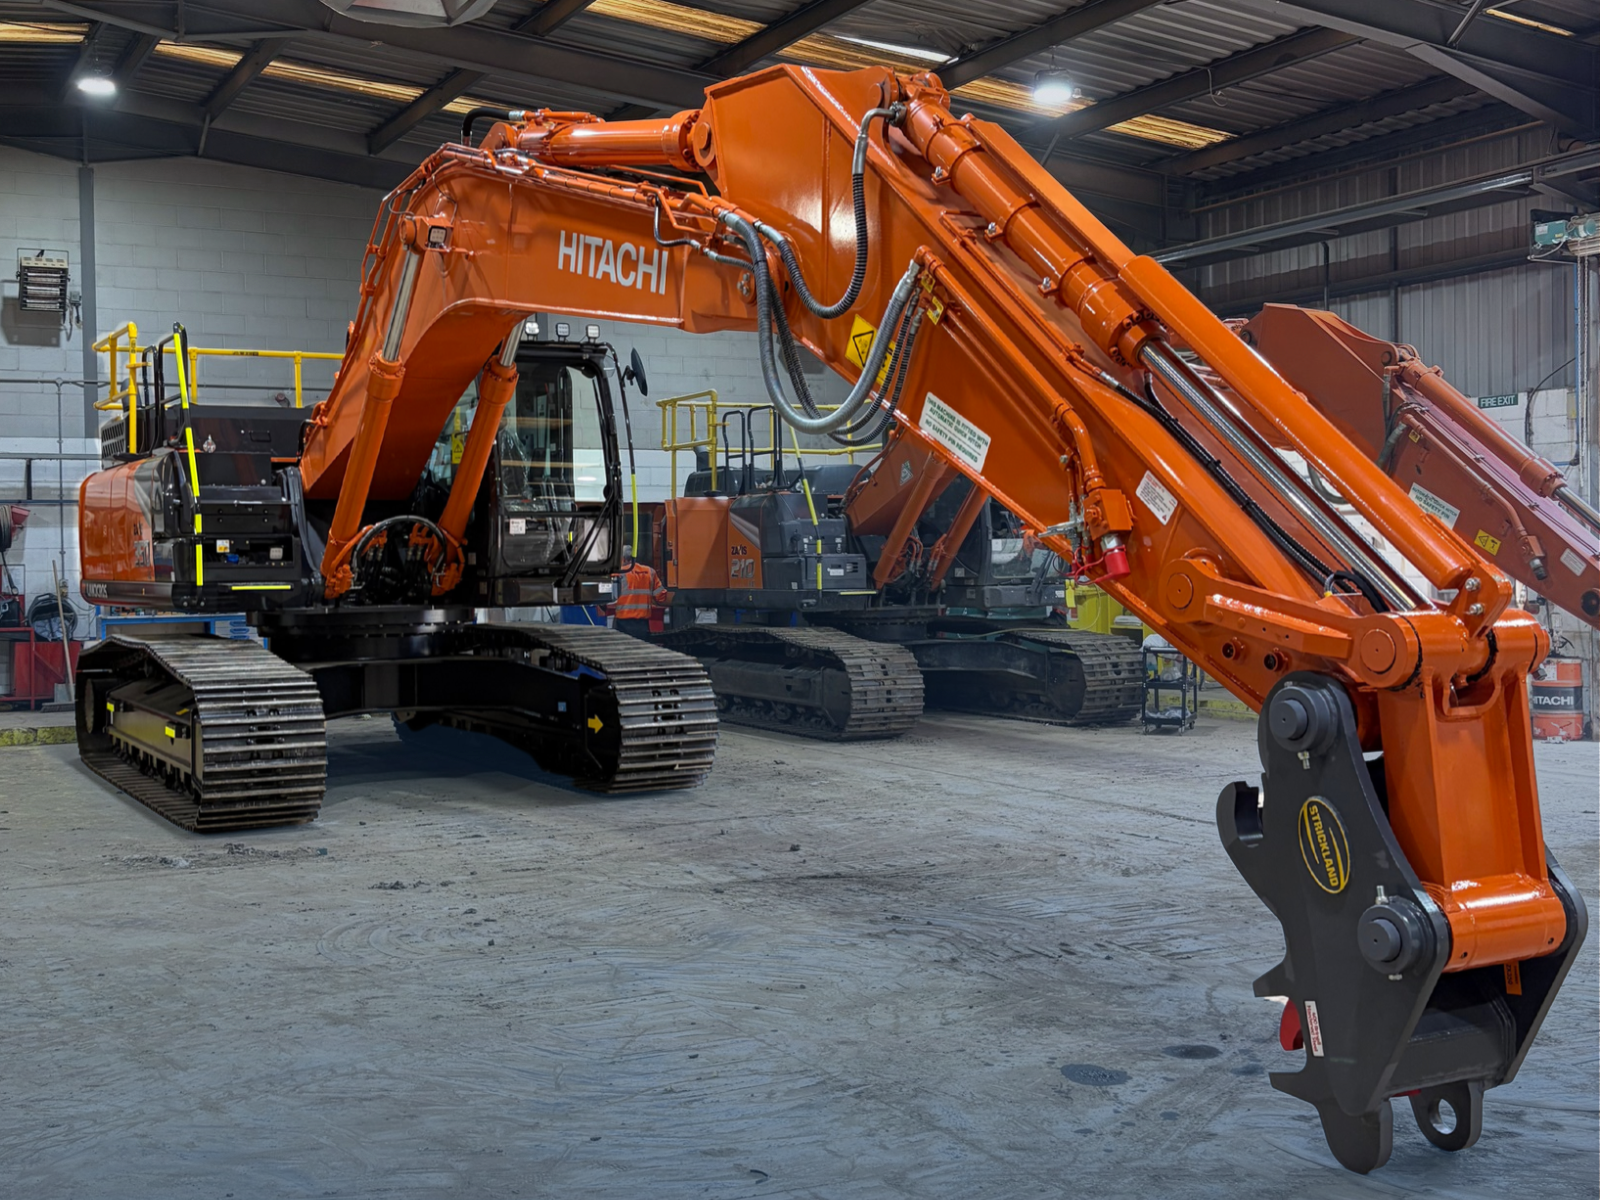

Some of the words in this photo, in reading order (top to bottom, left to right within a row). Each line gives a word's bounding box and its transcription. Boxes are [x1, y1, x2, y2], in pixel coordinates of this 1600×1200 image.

[558, 230, 669, 295] HITACHI
[1481, 397, 1497, 407] FIRE
[1498, 395, 1515, 405] EXIT
[925, 419, 933, 428] NO
[932, 424, 948, 439] SAFETY
[948, 436, 956, 446] PIN
[956, 442, 978, 463] REQUIRED
[929, 407, 954, 429] AUTOMATIC
[954, 426, 968, 439] QUICK
[968, 436, 982, 450] HITCH
[937, 404, 956, 423] MACHINE
[961, 423, 977, 438] FITTED
[977, 434, 989, 447] WITH
[1423, 500, 1441, 513] SAFETY
[1441, 511, 1450, 520] PIN
[731, 558, 755, 579] 210
[1309, 804, 1339, 887] STRICKLAND
